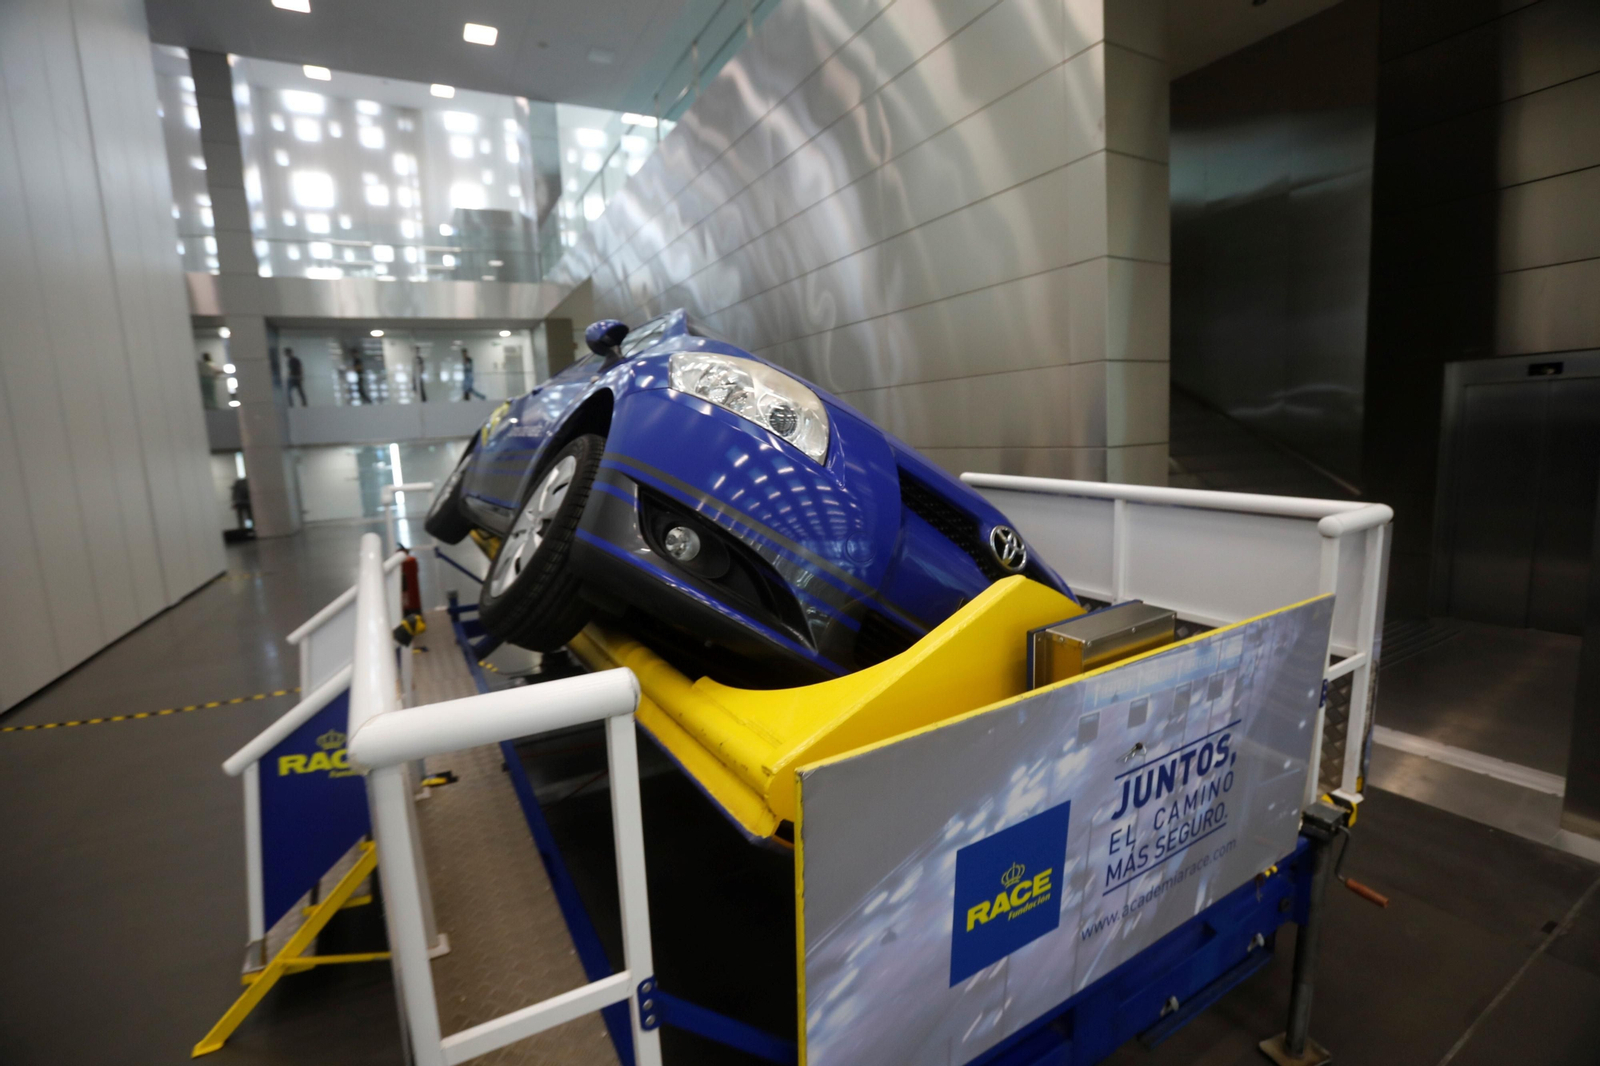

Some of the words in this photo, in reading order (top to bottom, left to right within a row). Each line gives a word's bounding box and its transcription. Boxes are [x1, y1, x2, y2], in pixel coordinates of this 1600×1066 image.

[278, 748, 350, 777] RAC
[1111, 733, 1236, 820] JUNTOS,
[1105, 845, 1149, 887] MÁS
[1155, 802, 1228, 859] SEGURO.
[1109, 824, 1136, 855] EL
[1154, 771, 1234, 831] CAMINO
[966, 867, 1052, 932] RACE
[1081, 838, 1237, 941] www.academiarace.com
